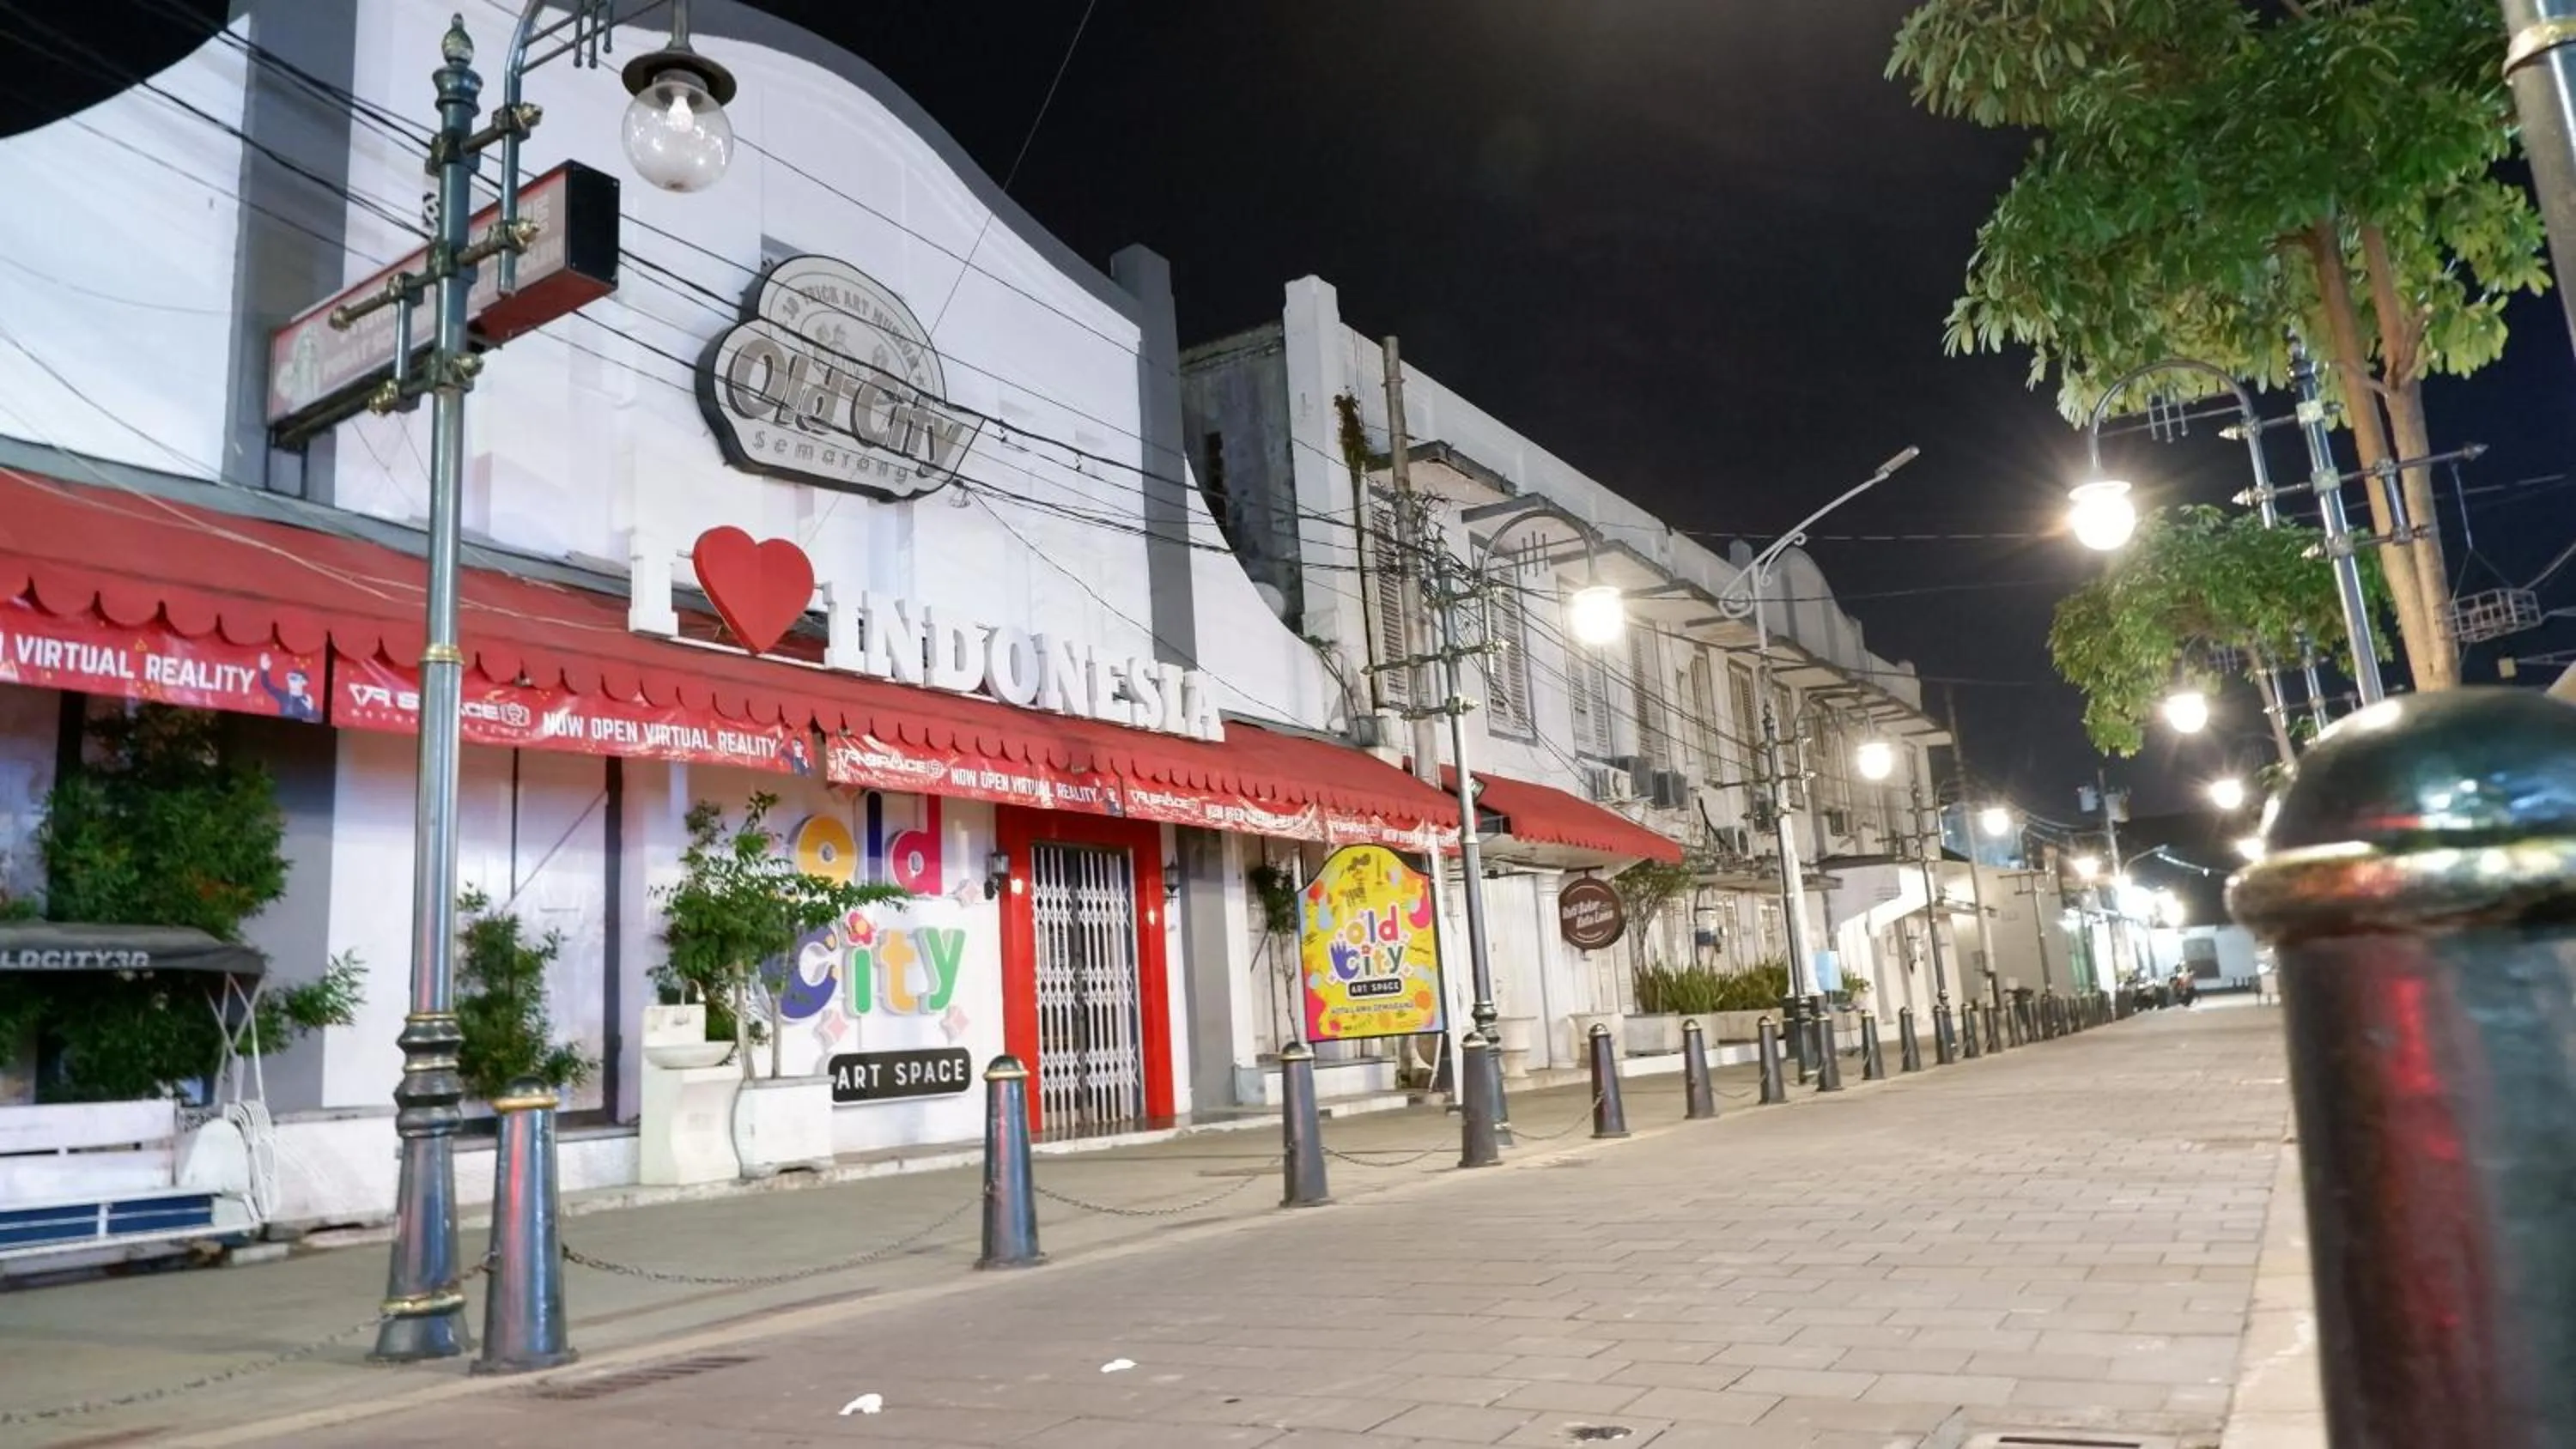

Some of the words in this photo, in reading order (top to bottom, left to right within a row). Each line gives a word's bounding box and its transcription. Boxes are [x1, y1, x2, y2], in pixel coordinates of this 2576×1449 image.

[628, 525, 678, 637] I
[15, 633, 135, 680] VIRTUAL
[144, 652, 256, 694] REALITY
[823, 581, 1225, 743] INDONESIA
[543, 712, 584, 737] NOW
[590, 716, 639, 743] OPEN
[642, 721, 714, 749] VIRTUAL
[717, 730, 778, 759] REALITY
[1346, 905, 1399, 944] old
[836, 1064, 882, 1090] ART
[894, 1058, 966, 1087] SPACE
